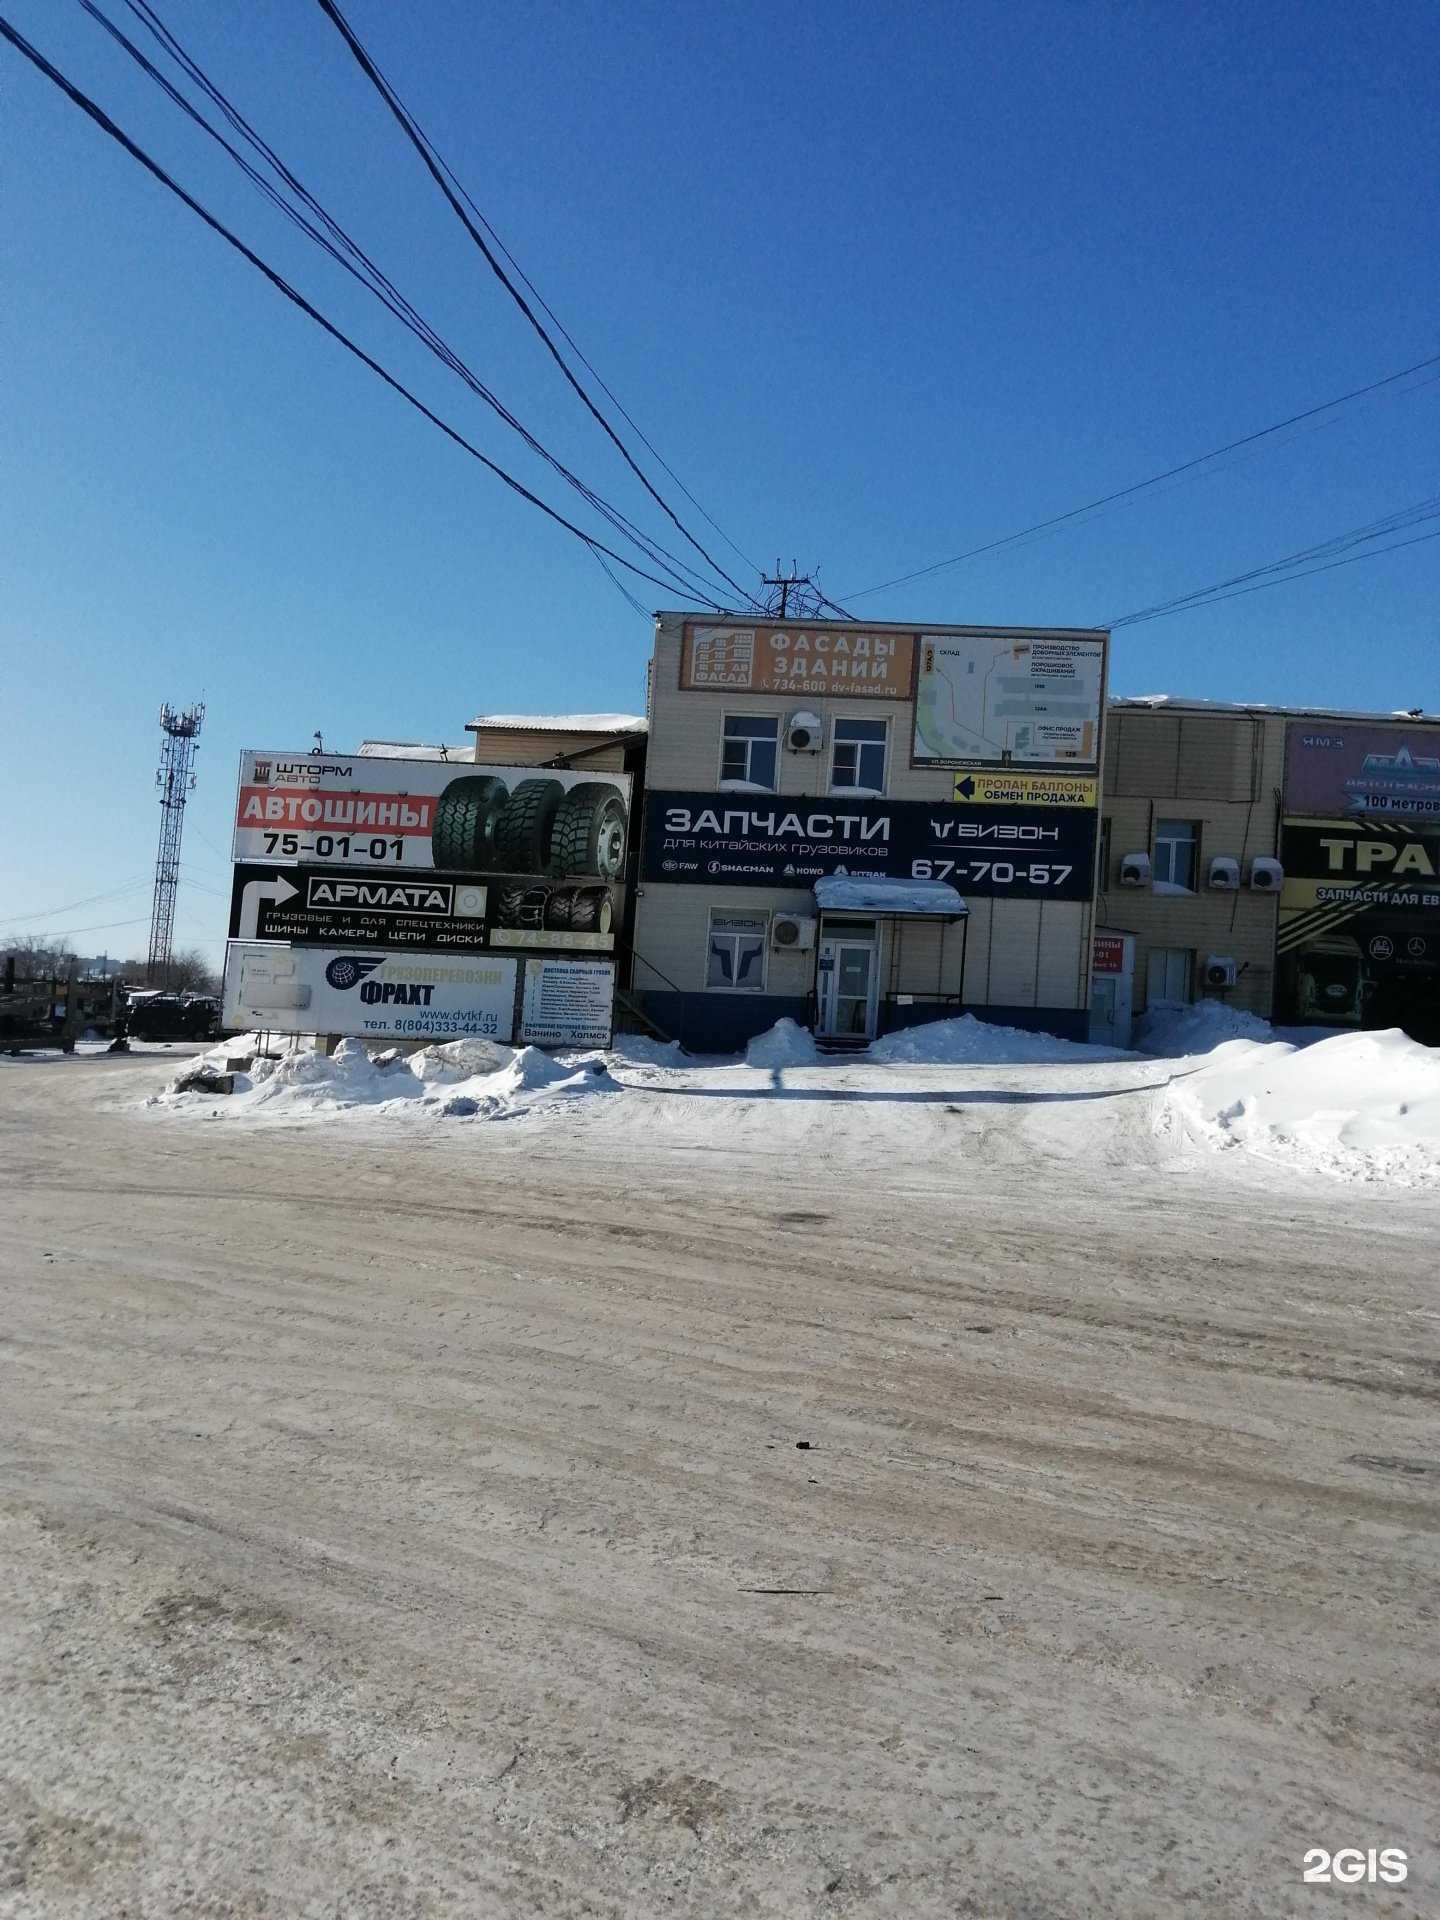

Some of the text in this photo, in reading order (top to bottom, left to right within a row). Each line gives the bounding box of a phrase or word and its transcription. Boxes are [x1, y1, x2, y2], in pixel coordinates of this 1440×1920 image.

[770, 633, 896, 657] ФАСАДЫ
[774, 655, 888, 680] ЗДАНИЙ
[695, 672, 748, 684] ФАСАД
[773, 679, 897, 696] 734-600 dv-fasad.ru
[274, 774, 321, 784] АВТО
[276, 763, 352, 777] ШТОРМ
[977, 778, 1093, 793] ПРОПАН БАЛЛОНЫ
[984, 790, 1086, 804] ОБМЕН ПРОДАЖА
[1365, 795, 1440, 813] 100 метров
[243, 795, 430, 828] АВТОШИНЫ
[664, 808, 1059, 841] ЗАПЧАСТИ БИЗОН
[263, 833, 404, 860] 75-01-01
[1320, 838, 1440, 876] ТРА
[678, 862, 699, 870] FAW
[721, 864, 774, 874] SHACMAN
[911, 859, 1073, 885] 67-70-57
[311, 884, 446, 908] АРМАТА
[1318, 889, 1388, 903] ЗАПЧАСТИ
[1392, 894, 1418, 905] ДЛЯ
[266, 912, 333, 923] ГРУЗОВЫЕ
[360, 917, 386, 926] ДЛЯ
[396, 919, 485, 931] СПЕЦТЕХНИКИ
[265, 924, 484, 944] ШИНЫ КАМЕРЫ ЦЕПИ ДИСКИ
[381, 965, 503, 985] ГРУЗОПЕРЕВОЗКИ
[360, 980, 435, 1005] ФРАХТ
[420, 1009, 498, 1023] www.dvtkf.ru
[364, 1019, 498, 1035] тел. 8(804)333-44-32
[524, 1028, 608, 1040] Ванино Холмск
